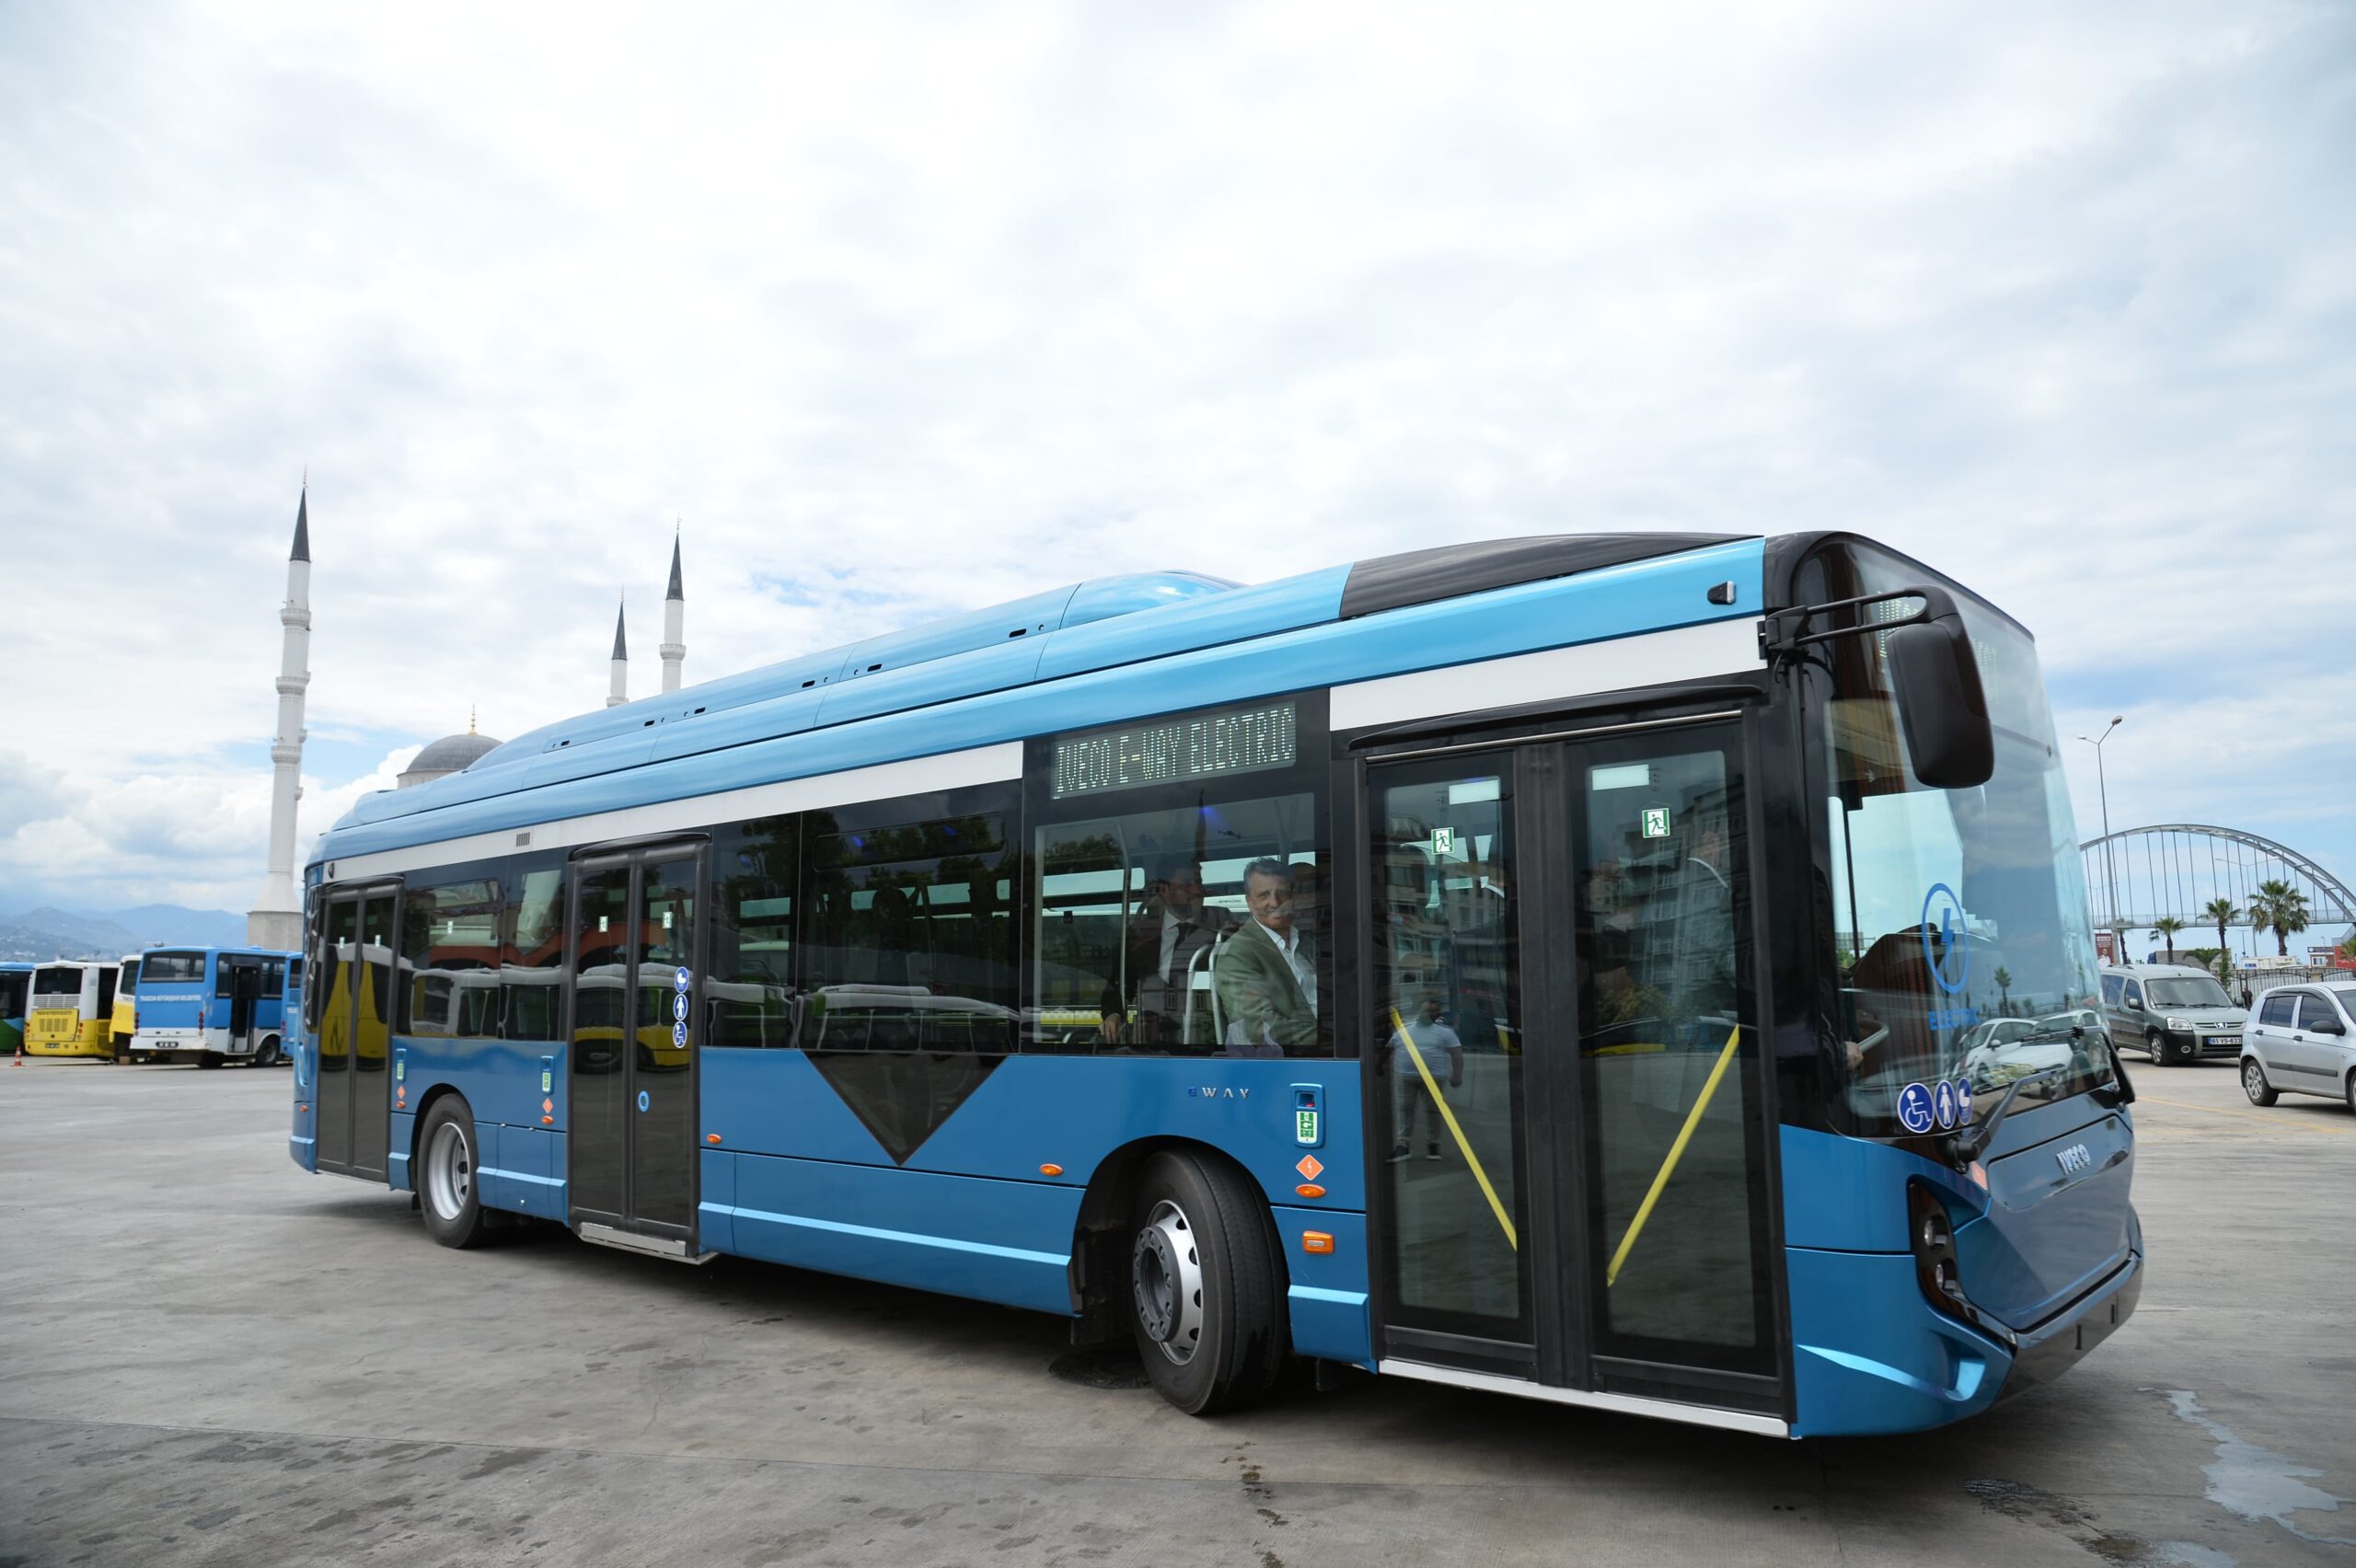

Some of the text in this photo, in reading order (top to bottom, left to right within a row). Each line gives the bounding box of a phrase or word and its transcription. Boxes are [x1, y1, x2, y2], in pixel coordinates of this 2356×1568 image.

[1057, 709, 1292, 792] IVECO E-WAY ELECTRIC
[2055, 1144, 2091, 1175] IVECO
